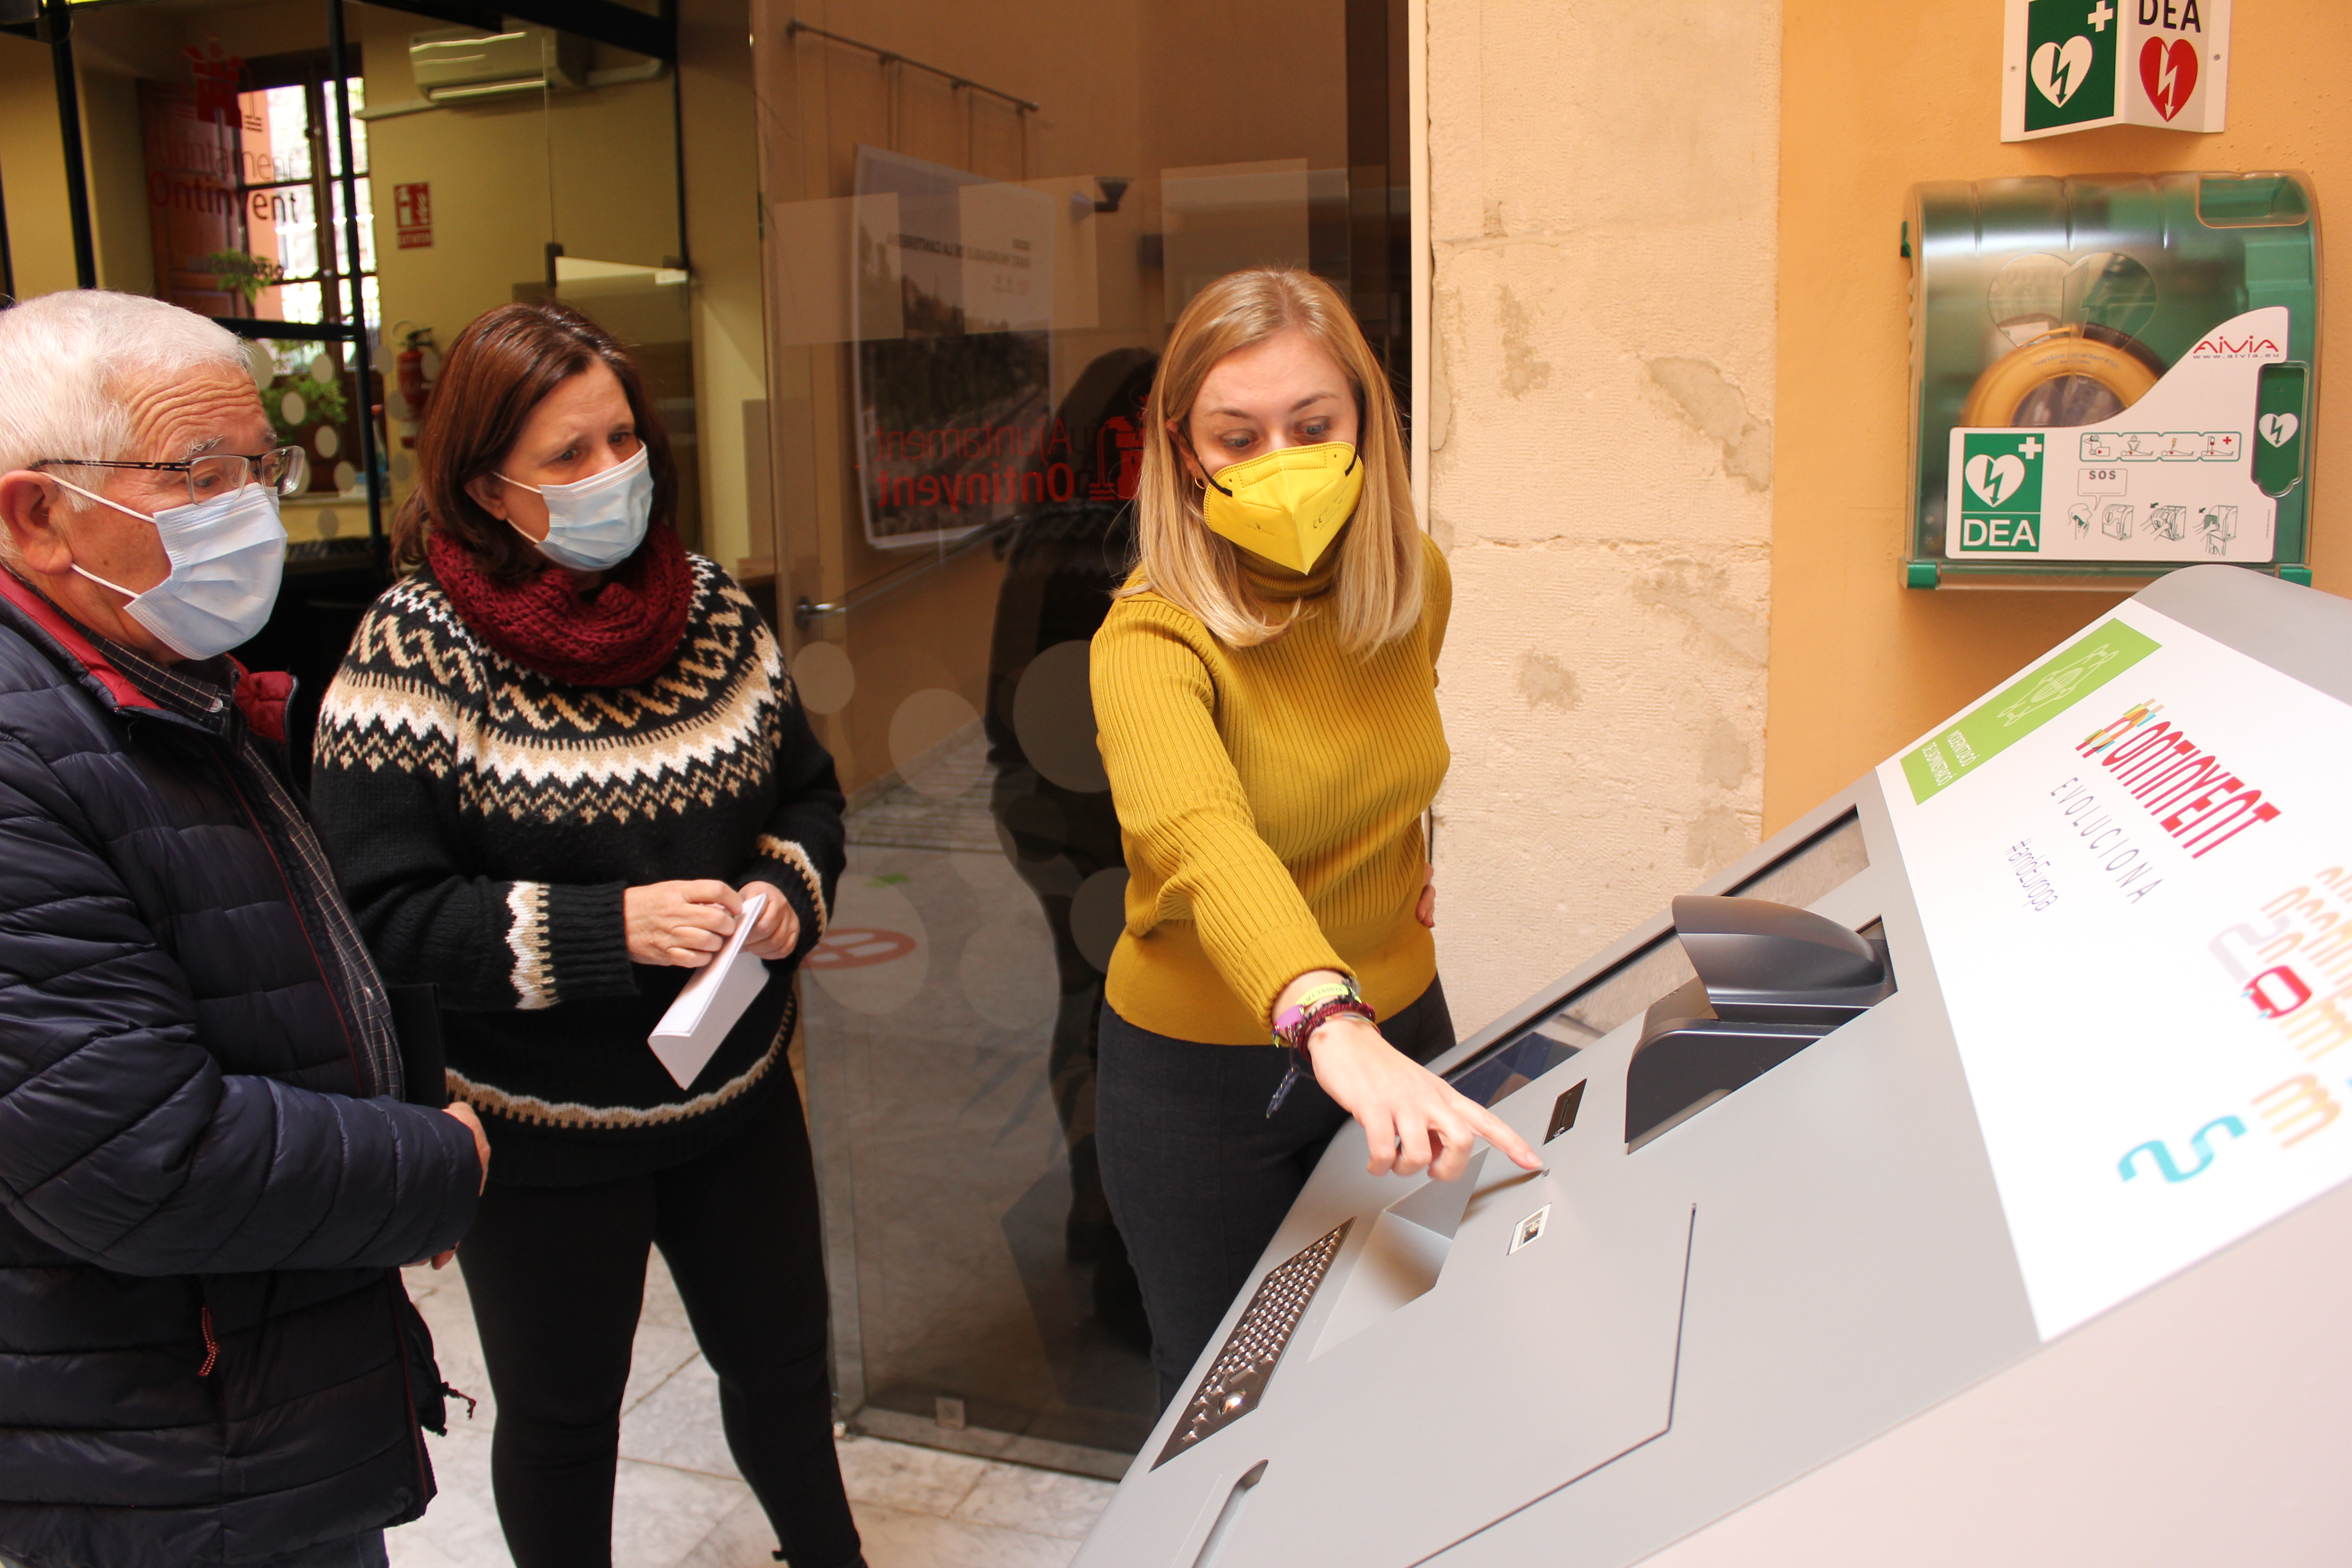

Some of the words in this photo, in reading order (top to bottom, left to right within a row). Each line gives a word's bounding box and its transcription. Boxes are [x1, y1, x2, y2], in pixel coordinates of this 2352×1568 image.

[2139, 0, 2201, 33] DEA
[2089, 470, 2116, 480] SOS
[1963, 519, 2037, 547] DEA
[2050, 777, 2163, 904] EVOLUCIONA
[2004, 838, 2058, 912] #ambEuropa
